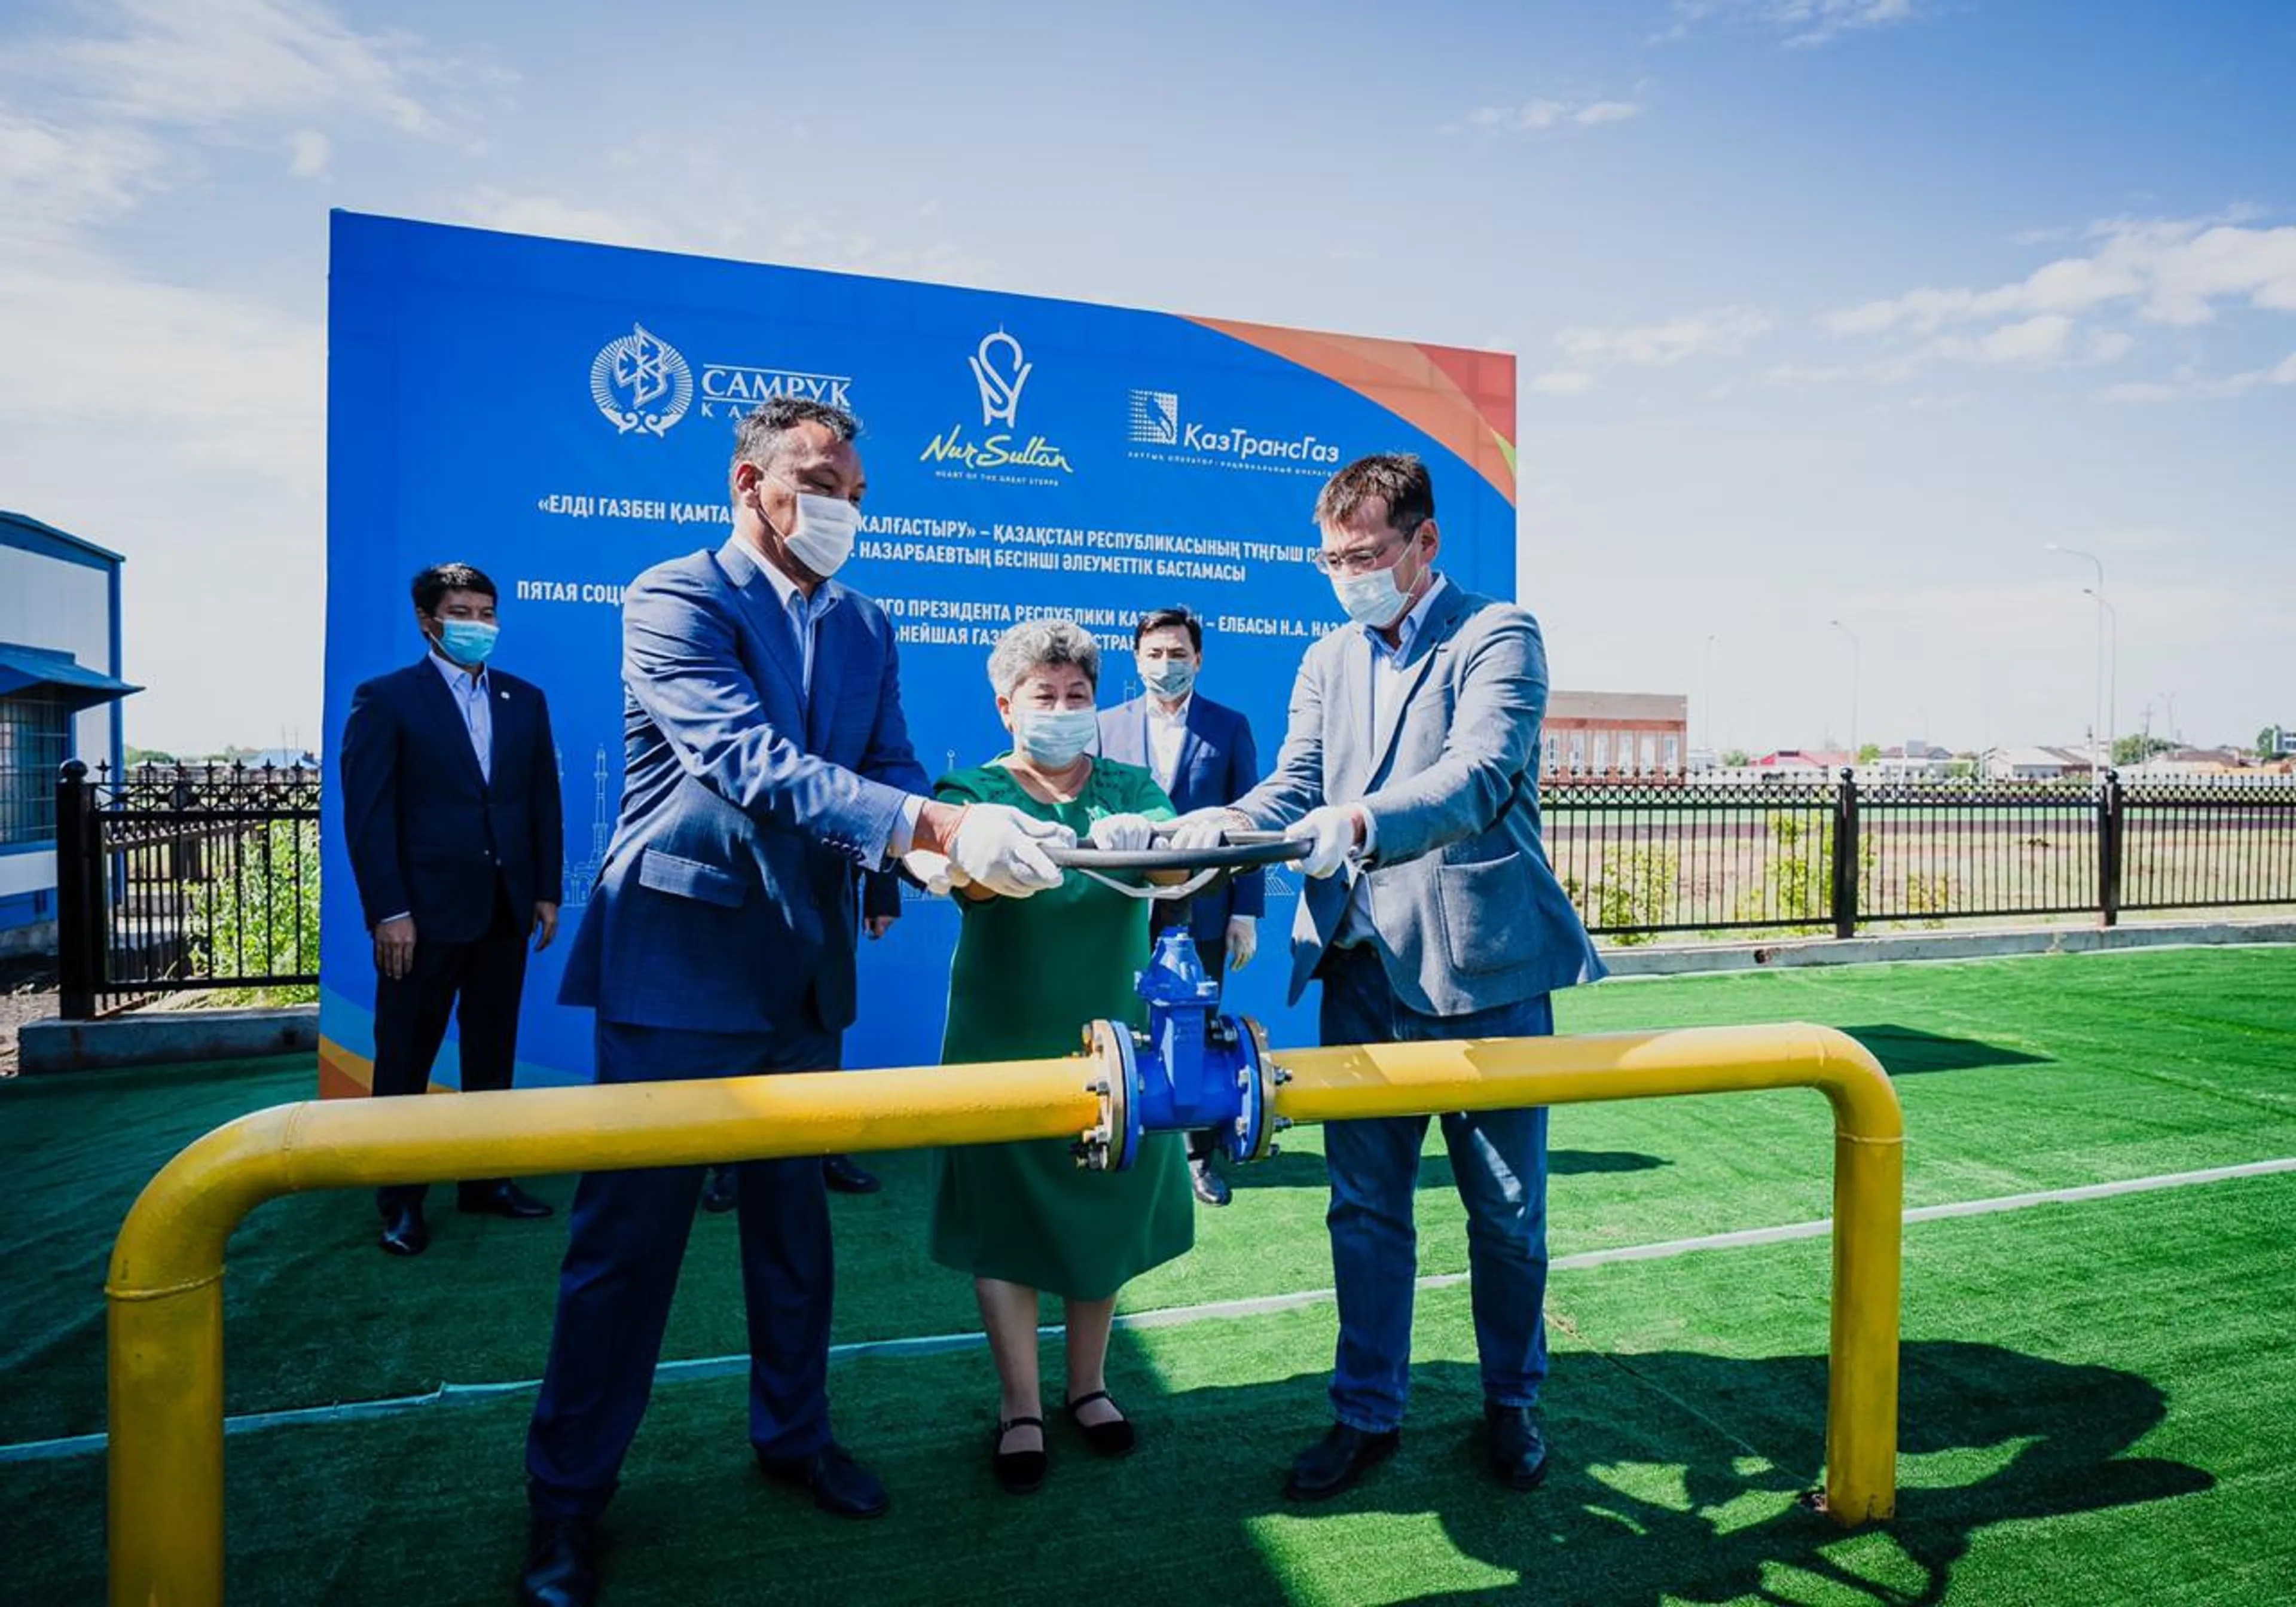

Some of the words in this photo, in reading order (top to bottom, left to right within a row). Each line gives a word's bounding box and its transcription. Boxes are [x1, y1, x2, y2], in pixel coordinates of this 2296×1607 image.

[702, 369, 851, 408] САМРУК
[1184, 422, 1339, 462] КазТрансГаз
[599, 497, 665, 520] ГАЗБЕН
[670, 502, 734, 524] ҚАМТА
[993, 524, 1083, 546] ҚАЗАҚСТАН
[1087, 530, 1240, 560] РЕСПУБЛИКАСЫНЫҢ
[859, 540, 991, 568] НАЗАРБАЕВТЫҢ
[994, 549, 1059, 570] БЕСІНШІ
[1062, 554, 1153, 575] ӘЛЕУМЕТТІК
[1156, 560, 1245, 582] БАСТАМАСЫ
[517, 581, 578, 601] ПЯТАЯ
[908, 598, 1011, 622] ПРЕЗИДЕНТА
[1015, 604, 1115, 626] РЕСПУБЛИКИ
[1218, 615, 1277, 636] ЕЛБАСЫ
[1280, 618, 1308, 637] Н.А.
